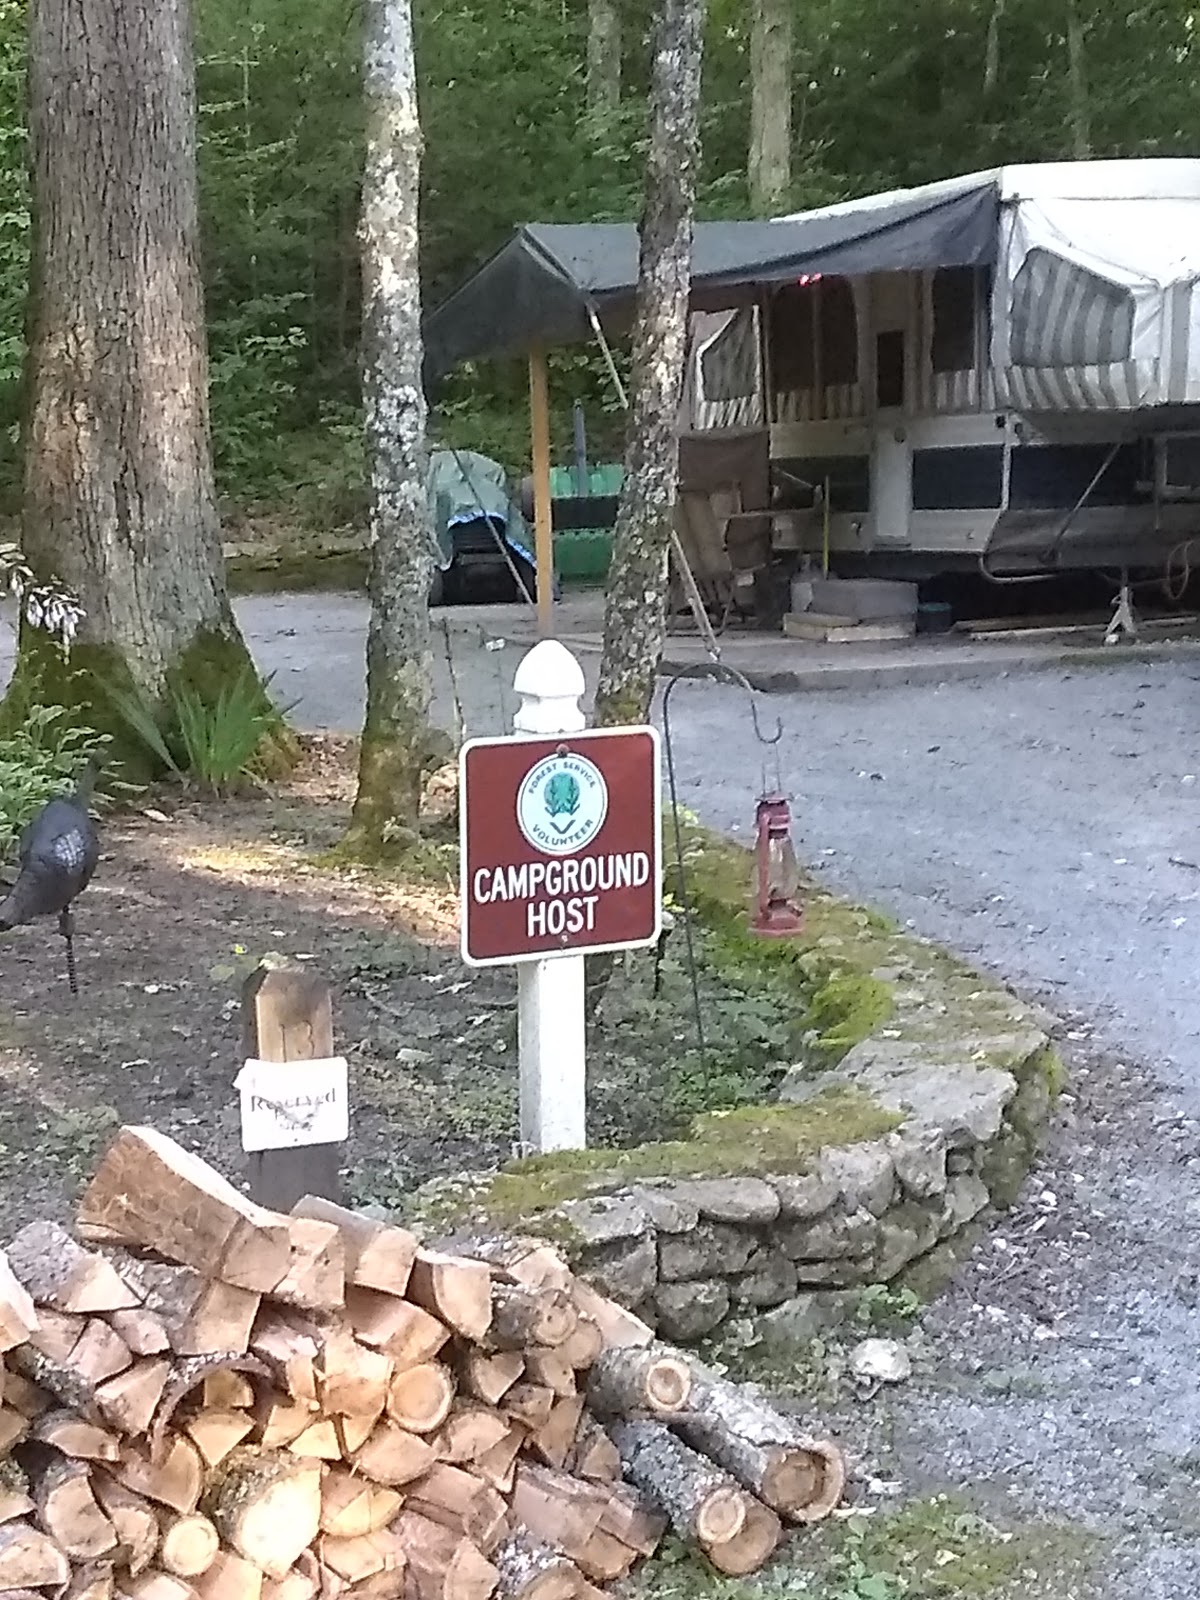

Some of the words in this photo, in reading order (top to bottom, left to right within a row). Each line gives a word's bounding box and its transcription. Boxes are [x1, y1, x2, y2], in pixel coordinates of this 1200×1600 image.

[528, 763, 557, 794] FOREST
[563, 761, 596, 788] SERVICE
[532, 819, 594, 845] VOLUNTEER
[473, 852, 649, 904] CAMPGROUND
[527, 896, 599, 938] HOST
